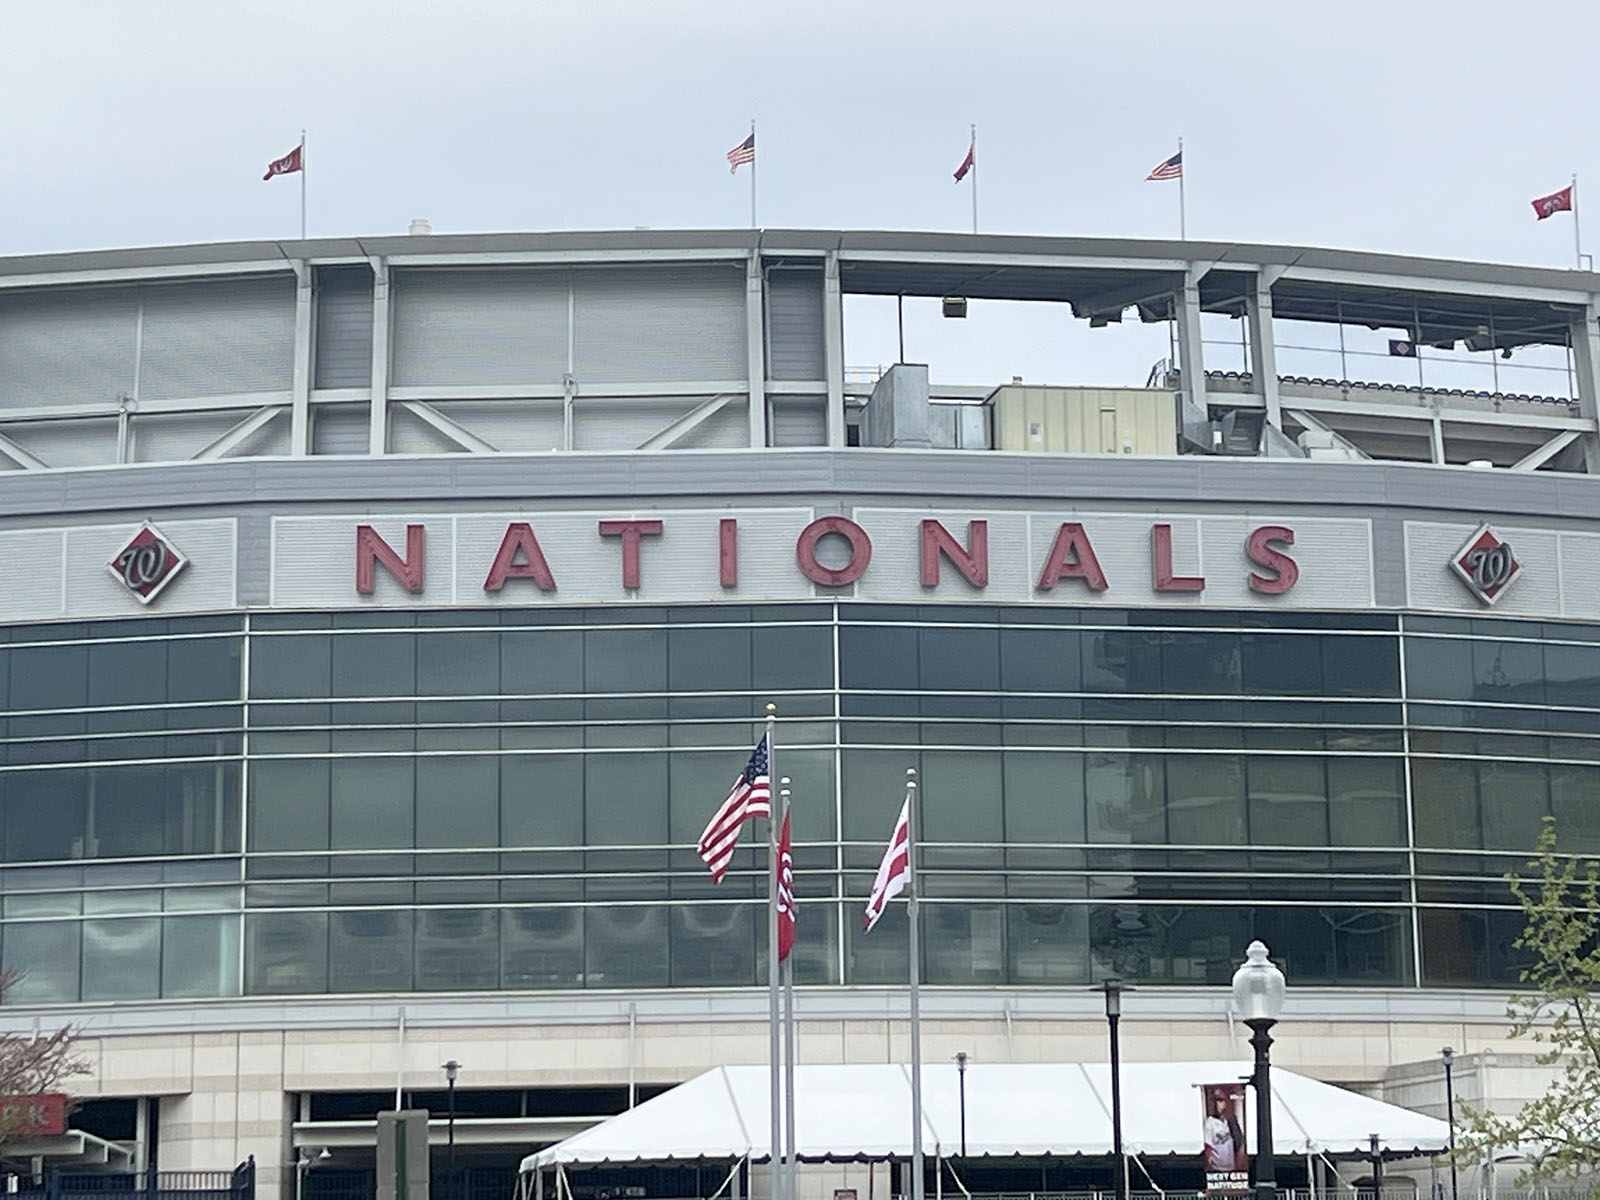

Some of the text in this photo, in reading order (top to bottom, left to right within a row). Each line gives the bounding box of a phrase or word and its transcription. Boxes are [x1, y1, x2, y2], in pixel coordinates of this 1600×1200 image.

[118, 537, 166, 590] W
[355, 515, 1299, 595] NATIONALS
[1466, 541, 1512, 591] W
